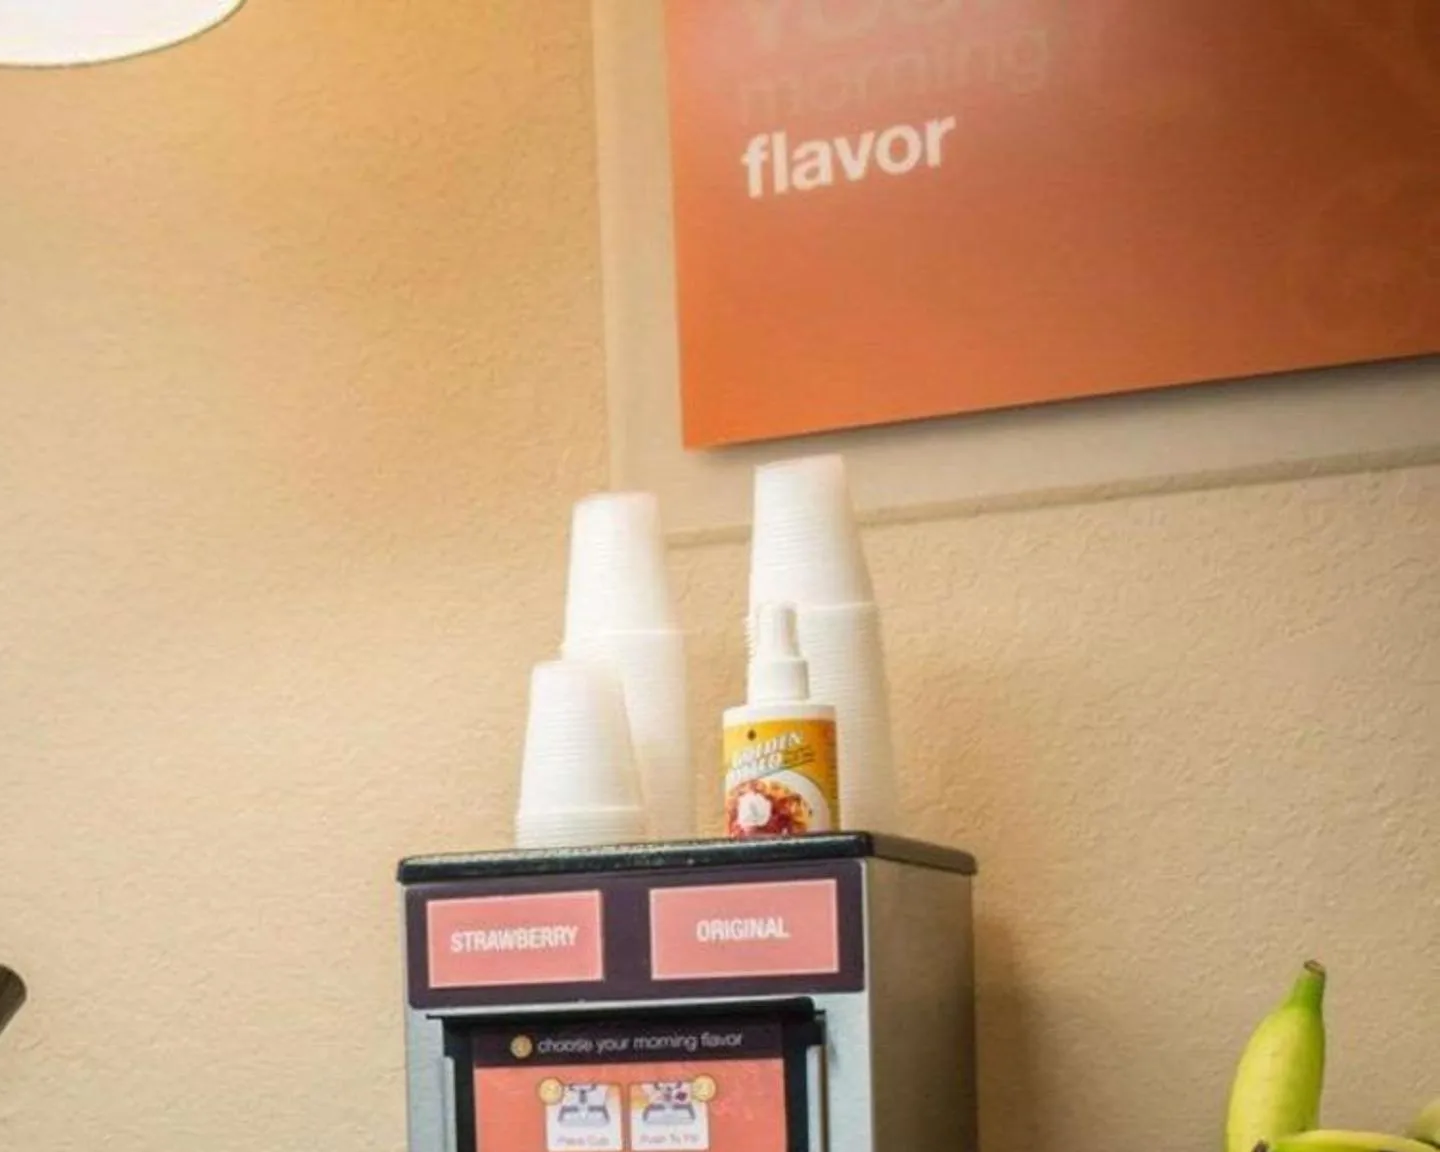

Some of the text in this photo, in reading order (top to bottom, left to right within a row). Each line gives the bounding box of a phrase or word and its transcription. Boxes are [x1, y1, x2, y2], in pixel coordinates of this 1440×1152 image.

[740, 115, 958, 200] flavor
[450, 925, 579, 953] STRAWBERRY
[696, 916, 792, 943] ORIGINAL
[538, 1031, 744, 1054] choose your morning flavor
